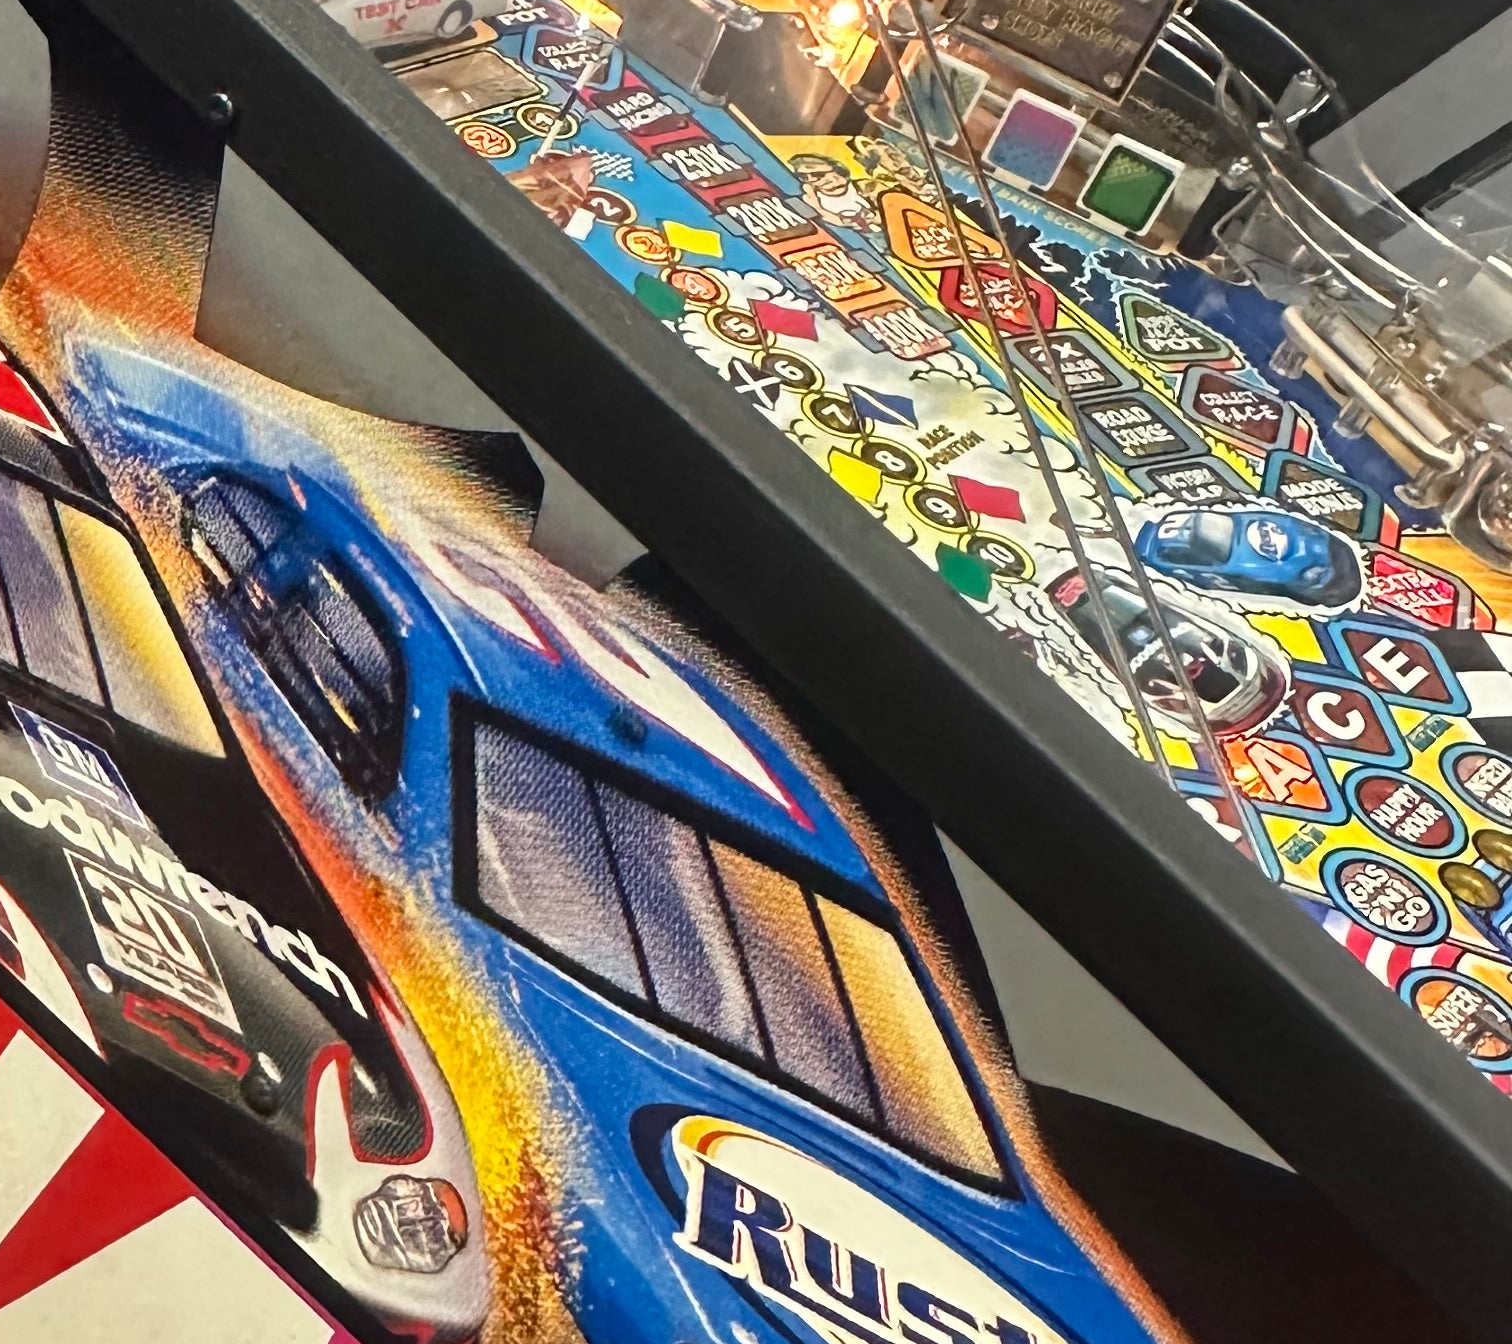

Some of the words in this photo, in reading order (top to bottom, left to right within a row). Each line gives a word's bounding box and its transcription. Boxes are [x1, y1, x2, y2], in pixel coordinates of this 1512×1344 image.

[354, 0, 401, 21] TEST
[496, 6, 550, 26] POT
[662, 143, 744, 182] 250K
[590, 197, 623, 216] 2
[727, 196, 808, 236] 200K
[724, 317, 756, 338] 5
[774, 360, 804, 381] 6
[820, 403, 851, 427] 7
[1091, 406, 1153, 429] ROAD
[874, 450, 907, 472] 8
[1279, 478, 1346, 500] MODE
[1295, 492, 1365, 517] BONUS
[979, 542, 1016, 570] 10
[1245, 740, 1314, 803] A
[1306, 691, 1366, 741] C
[1361, 636, 1431, 695] E
[37, 723, 119, 790] GM
[1369, 783, 1422, 830] HAPPY
[1394, 800, 1445, 843] HOUR
[1343, 863, 1390, 909] GAS
[83, 865, 210, 978] 20
[1385, 895, 1431, 933] GO
